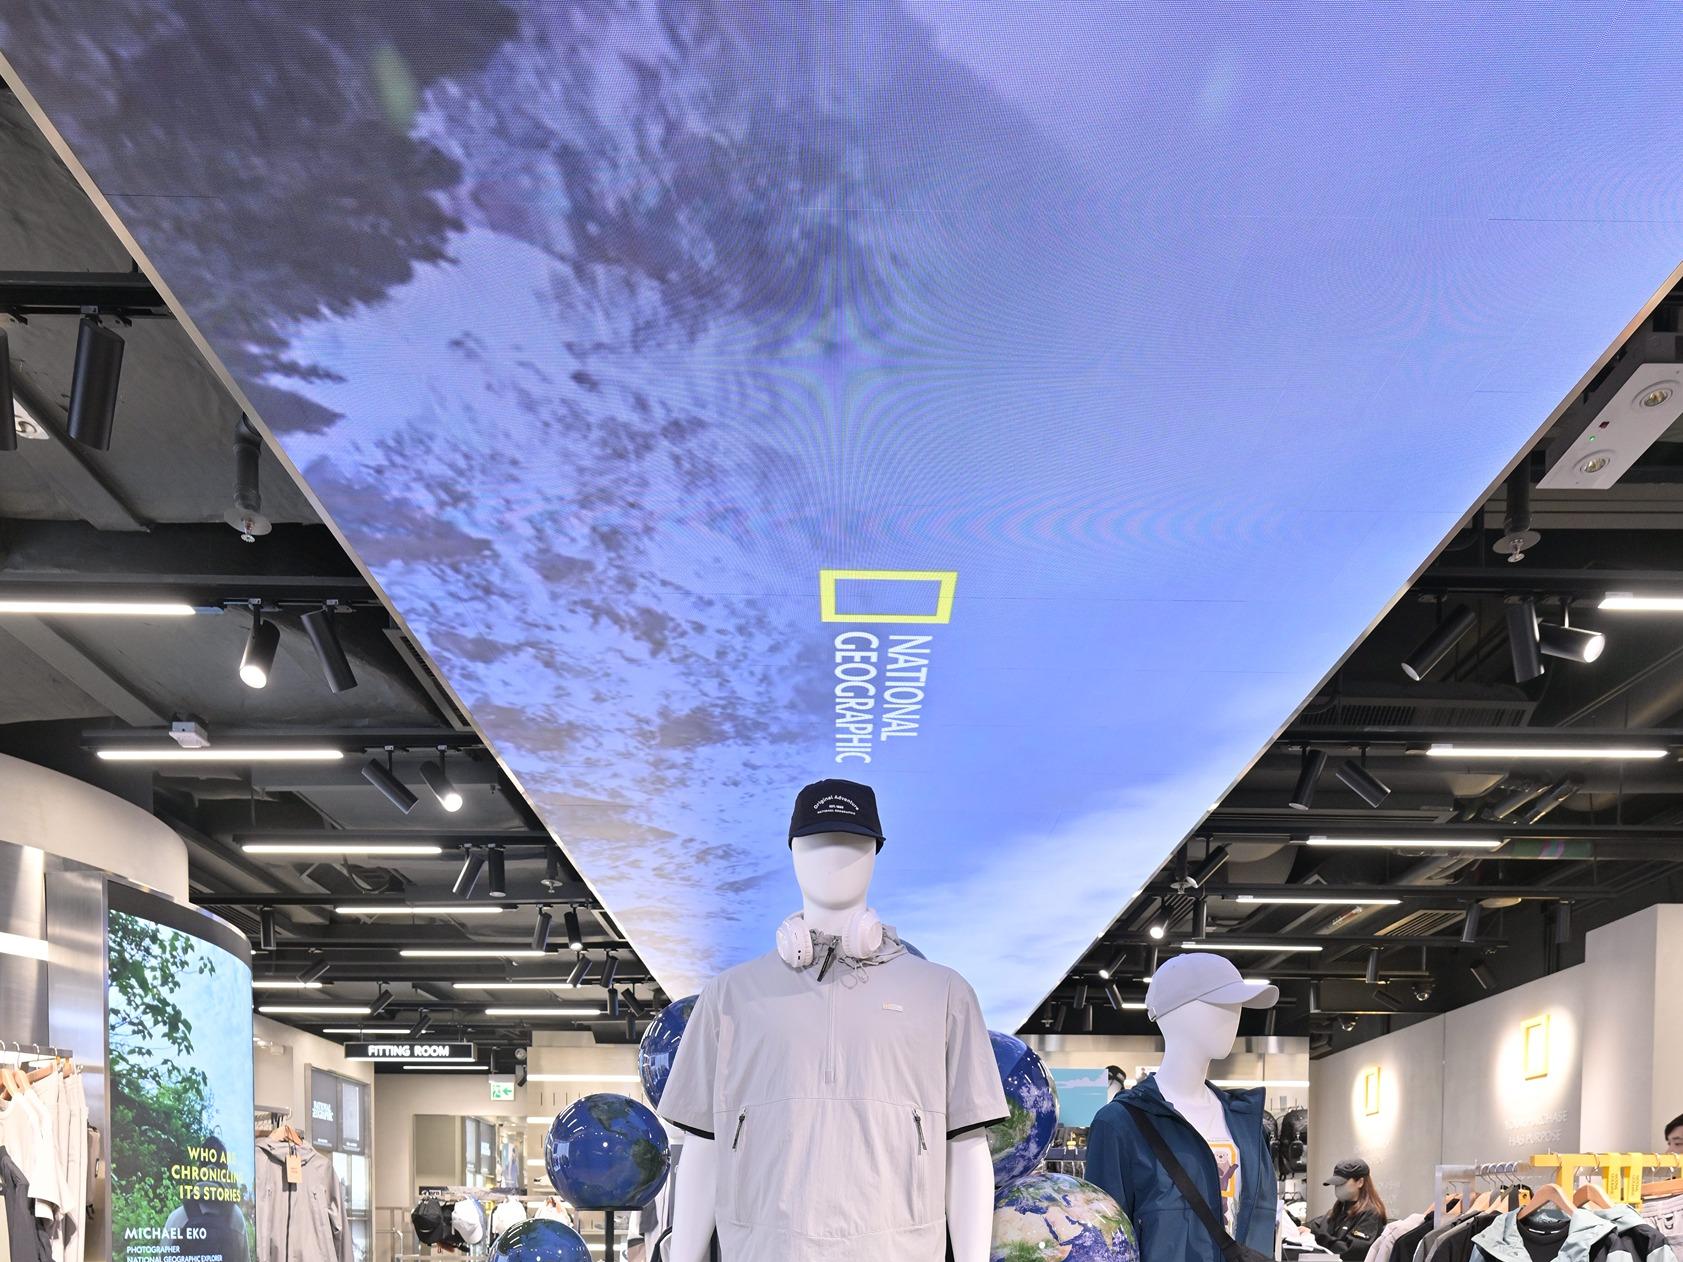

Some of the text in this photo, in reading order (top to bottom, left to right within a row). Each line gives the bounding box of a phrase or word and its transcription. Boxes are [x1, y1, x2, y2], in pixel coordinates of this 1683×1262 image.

[880, 635, 933, 741] NATIONAL
[834, 631, 879, 764] GEOGRAPHIC
[813, 795, 859, 811] Original Adventure
[368, 1045, 450, 1057] FITTING ROOM
[187, 1145, 217, 1162] WHO
[171, 1164, 244, 1184] CHRONICLIN
[179, 1184, 241, 1202] ITS STORIES
[124, 1227, 207, 1239] MICHAEL EKO
[126, 1245, 180, 1254] PHOTOGRAPHER
[163, 1255, 201, 1262] GEOGRAPHIC
[201, 1254, 223, 1262] EXPLORER
